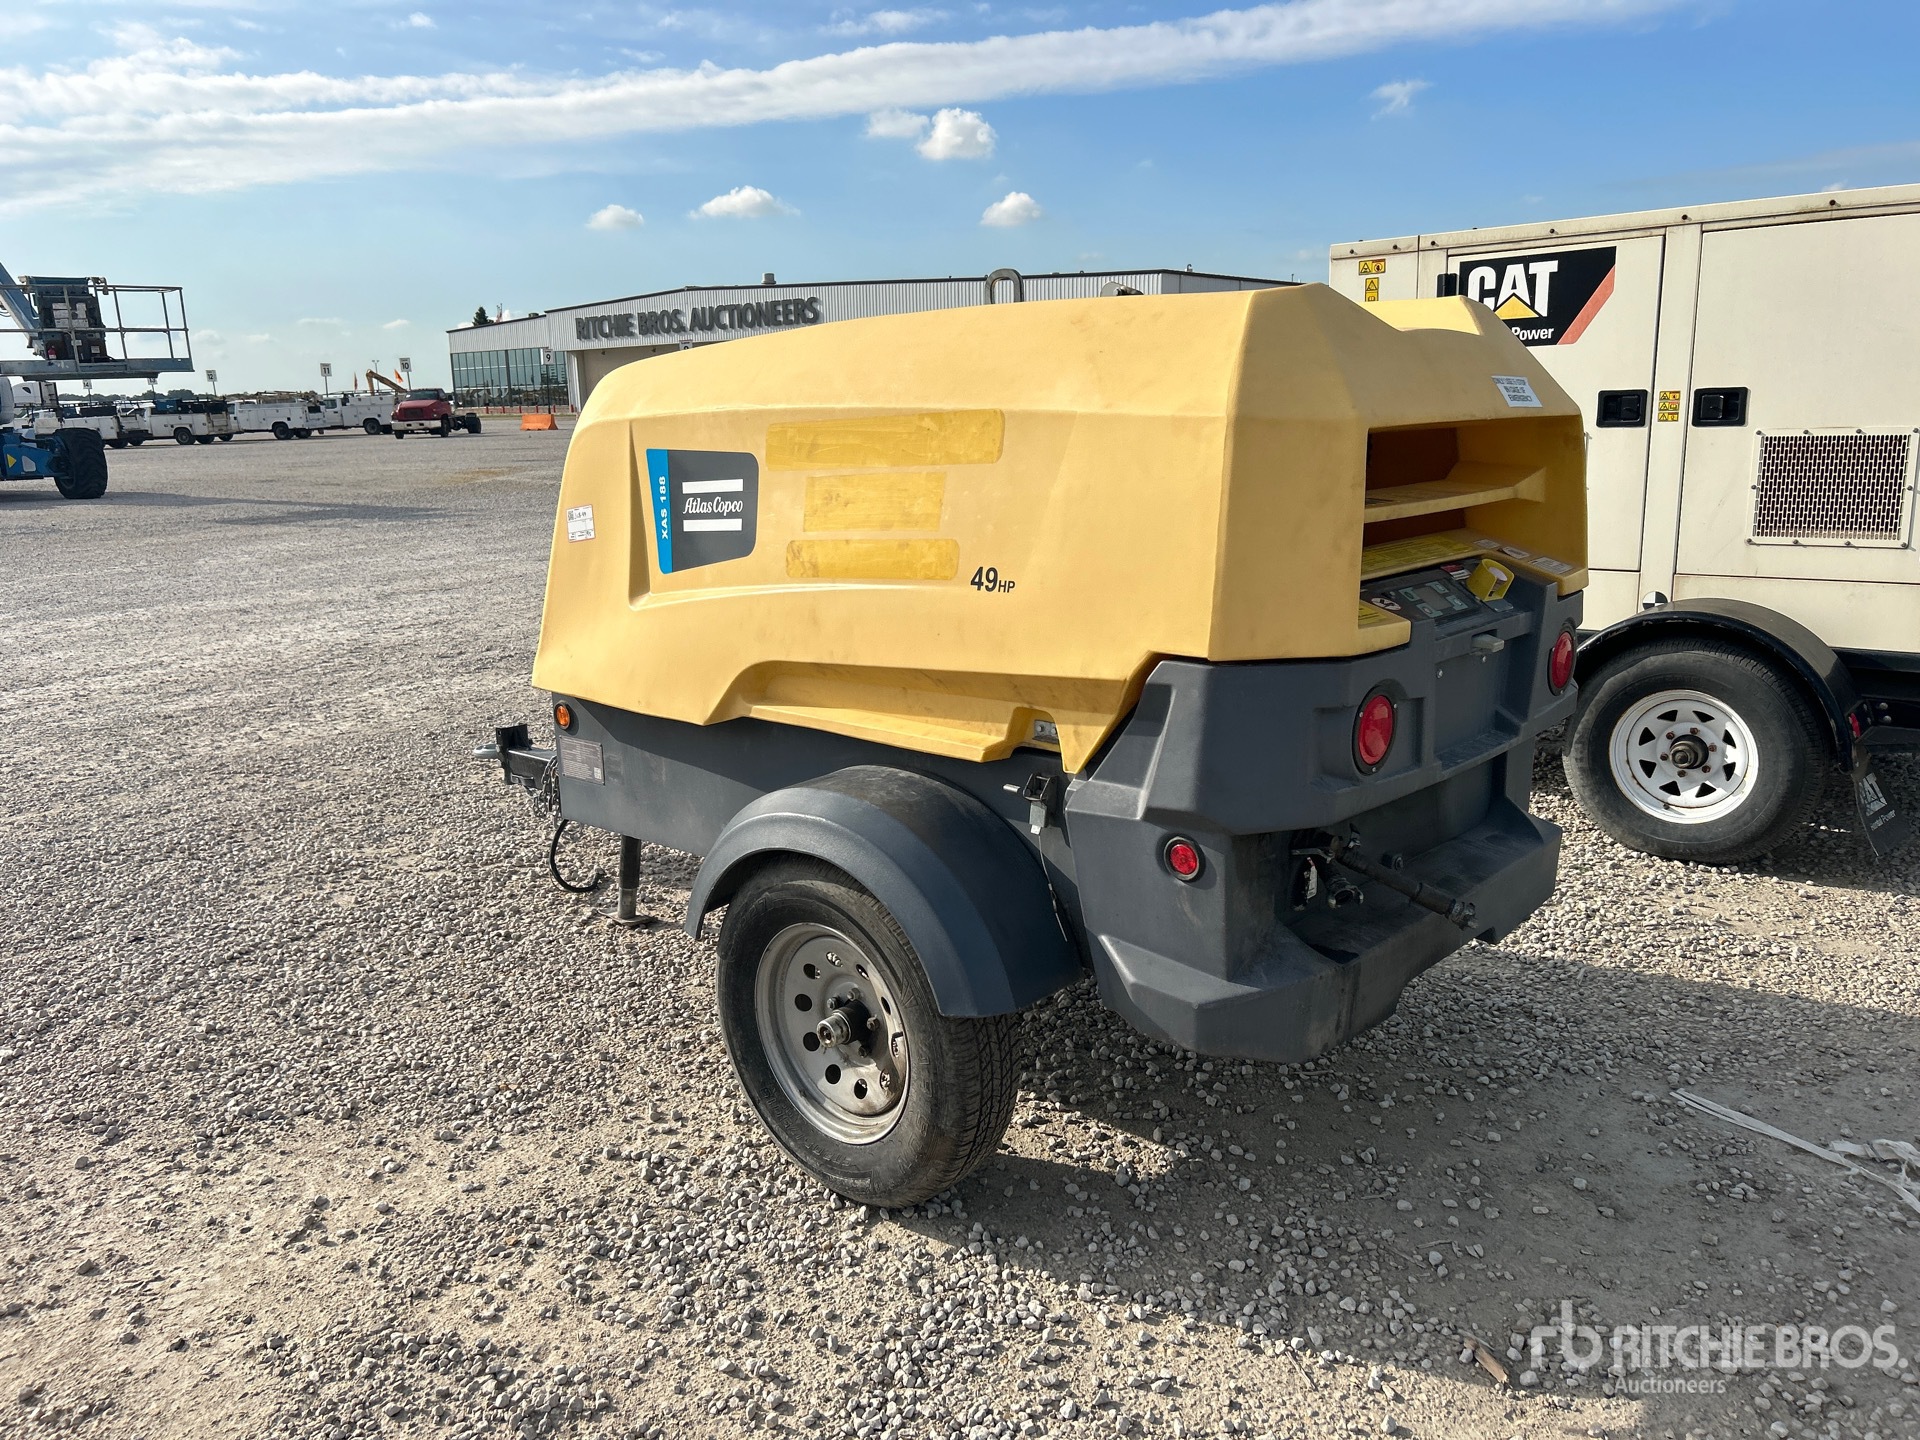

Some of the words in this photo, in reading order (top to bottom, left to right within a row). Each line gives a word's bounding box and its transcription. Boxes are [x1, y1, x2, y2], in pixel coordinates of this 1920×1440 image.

[1468, 260, 1559, 317] CAT
[576, 312, 637, 340] RITCHIE
[637, 308, 687, 336] BROS.
[689, 297, 820, 332] AUCTIONEERS
[658, 475, 667, 503] 188
[660, 508, 669, 540] XAS
